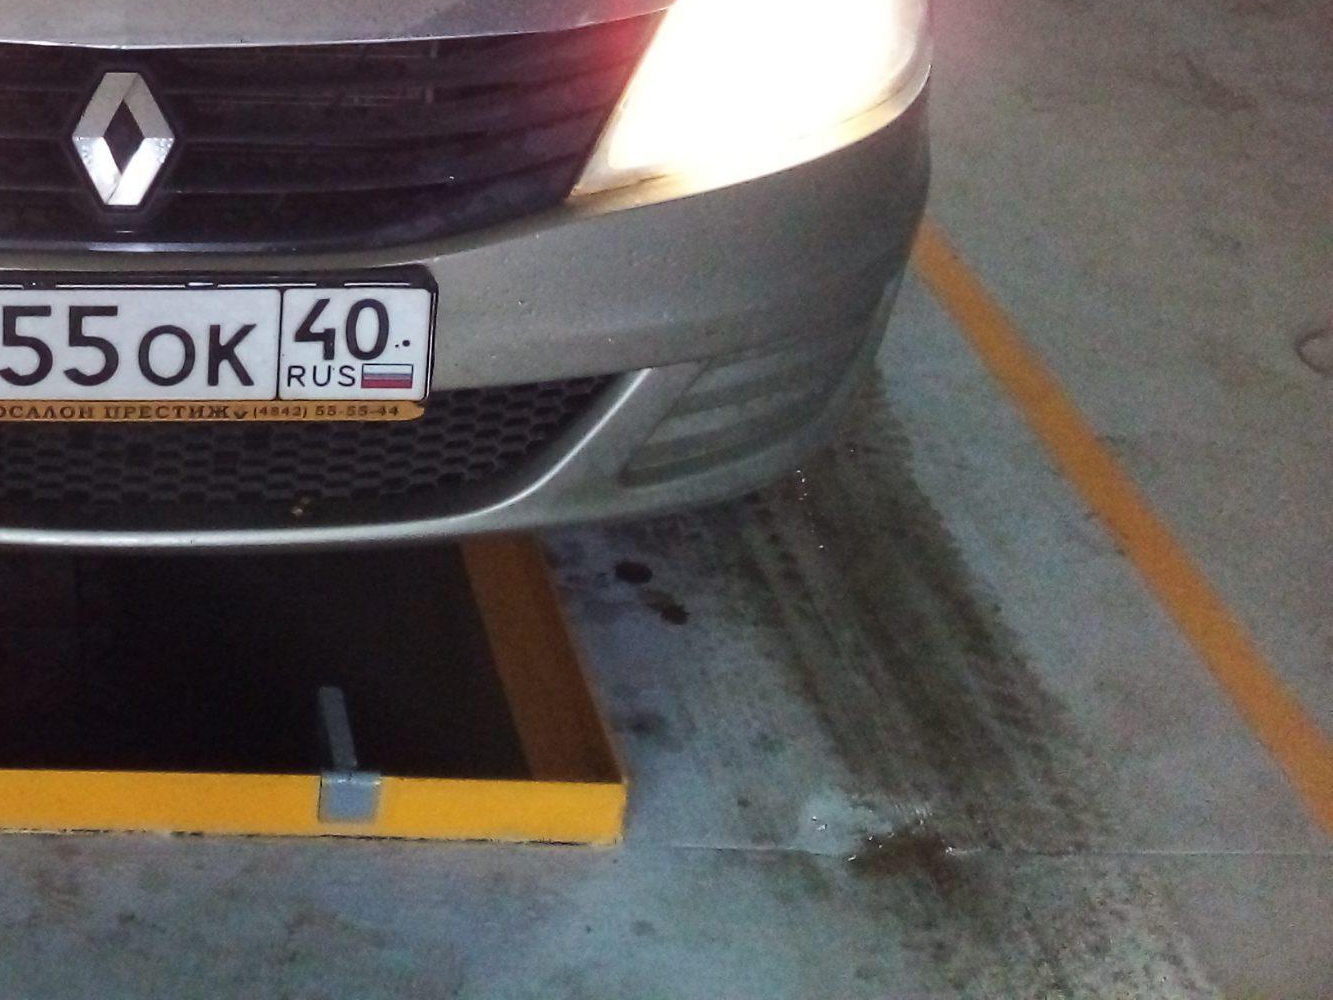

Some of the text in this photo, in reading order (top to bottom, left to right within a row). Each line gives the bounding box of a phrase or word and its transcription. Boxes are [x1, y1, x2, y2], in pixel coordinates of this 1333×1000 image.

[293, 298, 390, 361] 40
[287, 365, 357, 387] RUS
[103, 404, 230, 420] ПРЕСТИЖ
